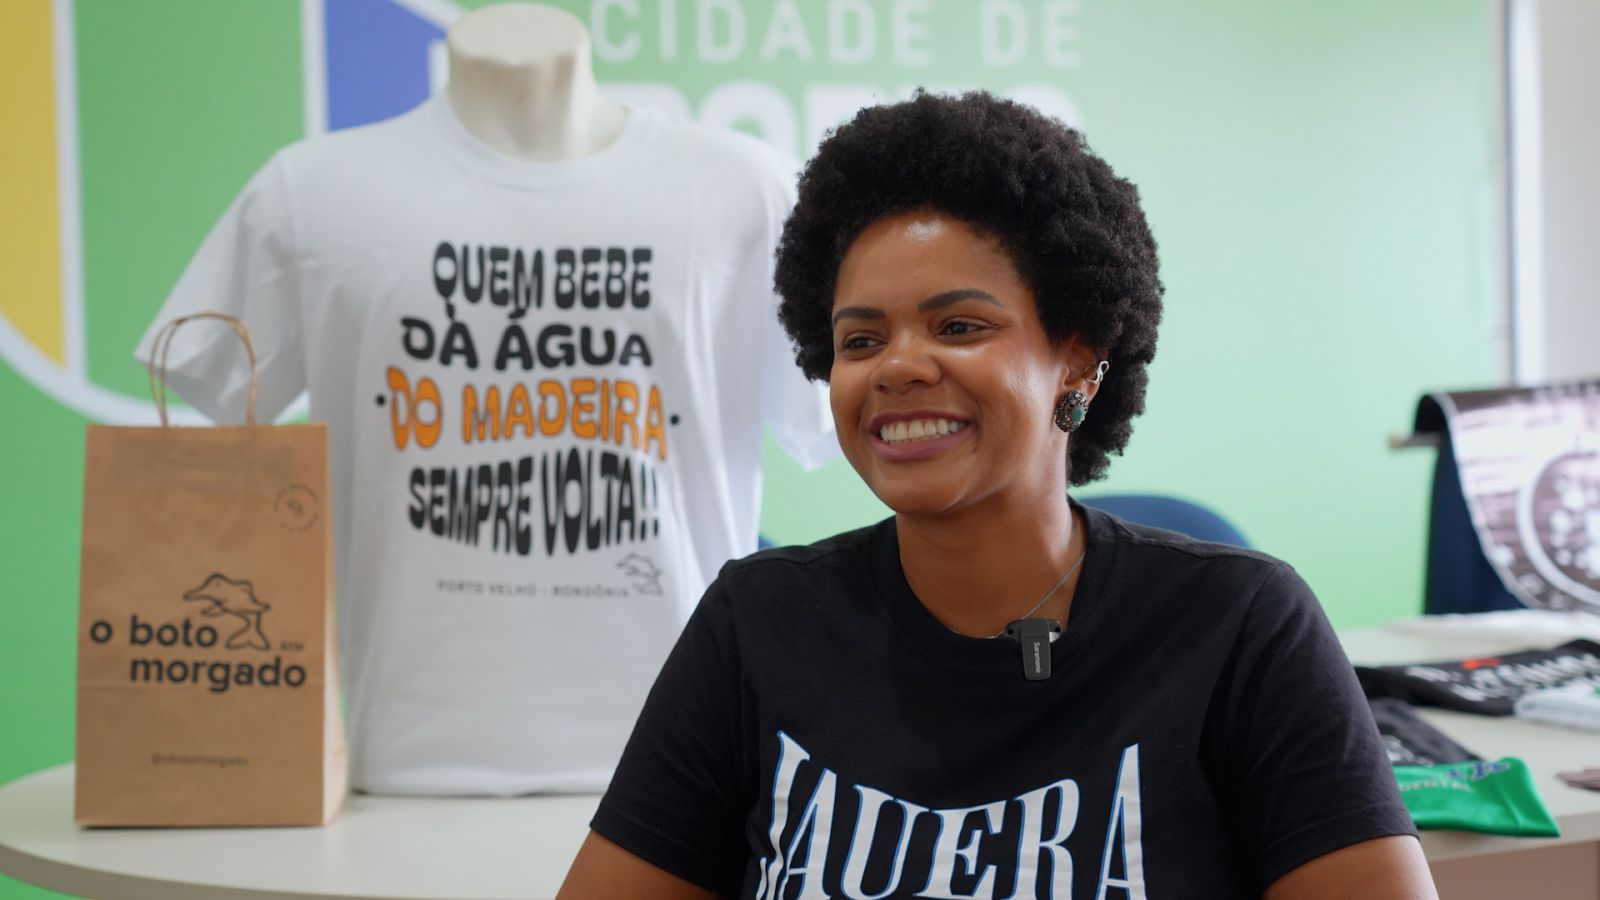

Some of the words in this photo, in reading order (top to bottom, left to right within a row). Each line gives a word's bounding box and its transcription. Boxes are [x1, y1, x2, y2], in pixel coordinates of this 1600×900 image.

[591, 0, 932, 65] CIDADE
[982, 0, 1084, 67] DE
[433, 242, 545, 312] QUEM
[553, 247, 652, 310] BEBE
[494, 308, 653, 371] ÁGUA
[386, 365, 443, 452] DO
[462, 377, 667, 462] MADEIRA
[408, 456, 535, 557] SEMPRE
[543, 447, 660, 558] VOLTA!!
[437, 578, 486, 595] PORTO
[489, 581, 538, 597] VELHO
[89, 619, 113, 645] o
[128, 613, 219, 649] boto
[1033, 641, 1041, 674] Saramonic
[129, 655, 307, 694] morgado
